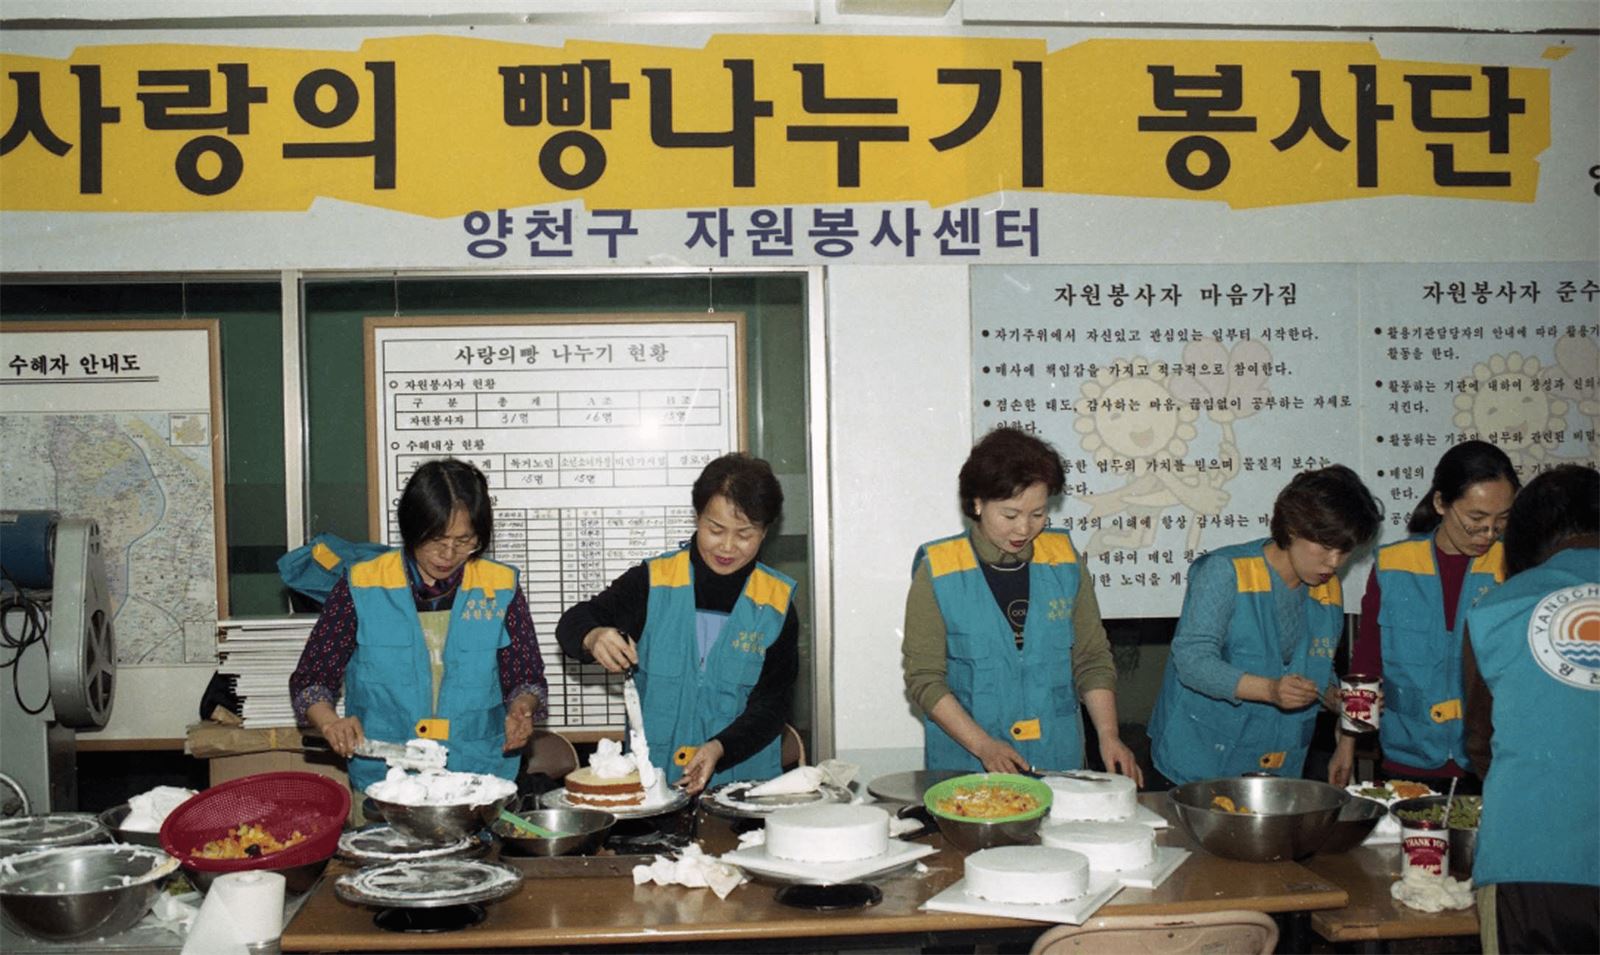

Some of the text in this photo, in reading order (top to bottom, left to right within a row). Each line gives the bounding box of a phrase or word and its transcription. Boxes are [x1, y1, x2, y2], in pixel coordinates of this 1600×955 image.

[0, 59, 1526, 196] 사랑의 빵나누기 봉사단
[464, 208, 1039, 259] 양천구 자원봉사센터
[1055, 283, 1296, 307] 자원봉사자 마음가짐
[1424, 281, 1540, 304] 자원봉사자
[996, 327, 1318, 342] 자기주위에서 자신있고 관심있는 일부터 시작한다.
[1493, 326, 1526, 339] 안내에
[1536, 325, 1557, 338] 따라
[455, 343, 669, 365] 사랑의빵 나누기 현황
[1432, 347, 1459, 360] 한다.
[9, 354, 140, 376] 수혜자 안내도
[1109, 363, 1149, 377] 가지고
[1159, 363, 1224, 376] 적극적으로
[1235, 362, 1291, 376] 참여한다.
[406, 379, 464, 391] 자원봉사자
[1445, 380, 1478, 393] 기관에
[1574, 377, 1600, 389] 신의
[413, 398, 423, 408] 구
[448, 398, 457, 407] 분
[1087, 398, 1140, 412] 감사하는
[1150, 398, 1181, 411] 마음,
[1252, 396, 1304, 410] 공부하는
[1314, 395, 1351, 408] 자세로
[1390, 401, 1428, 413] 지킨다.
[1487, 431, 1523, 445] 업무와
[1573, 430, 1600, 442] 비밀
[1097, 459, 1135, 473] 업무의
[1147, 458, 1185, 472] 가치를
[1195, 458, 1232, 472] 믿으며
[1391, 487, 1418, 500] 한다.
[1063, 517, 1101, 532] 직장의
[1162, 515, 1186, 529] 항상
[1197, 514, 1249, 529] 감사하는
